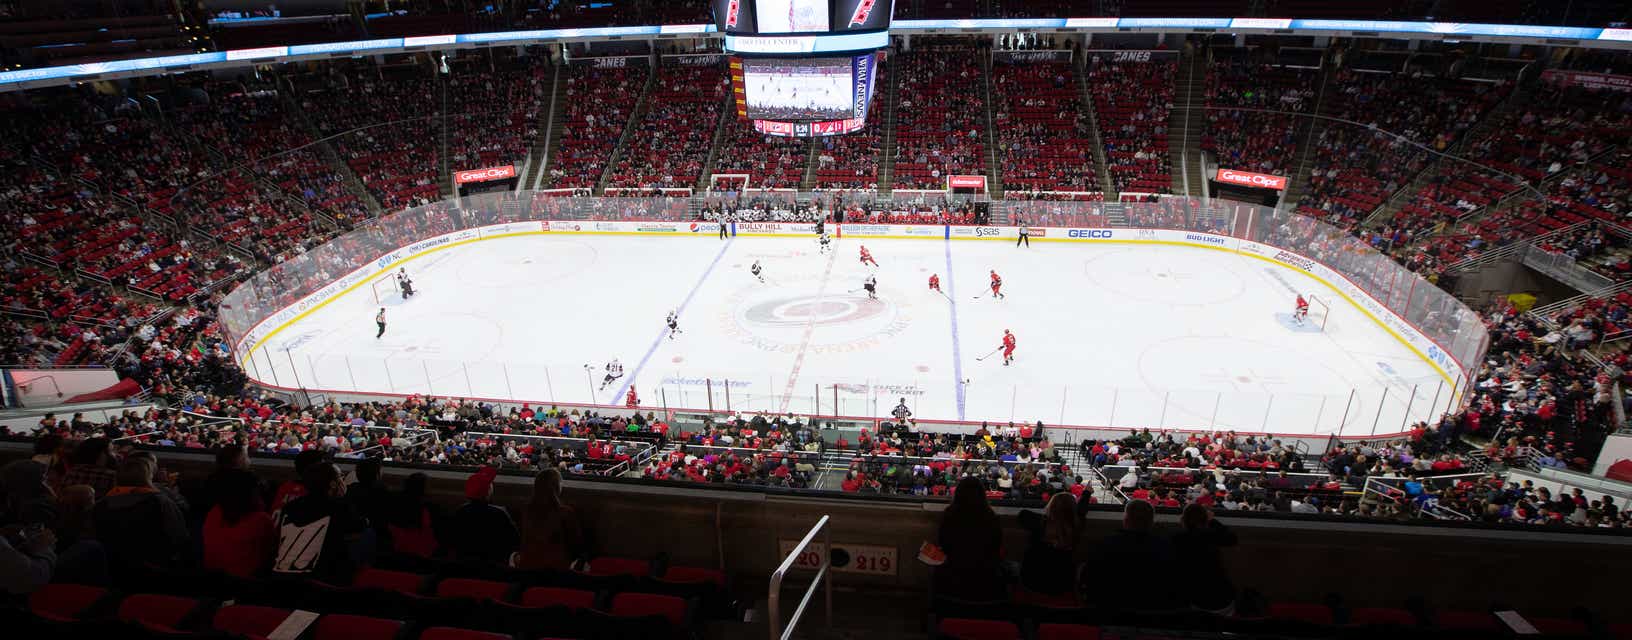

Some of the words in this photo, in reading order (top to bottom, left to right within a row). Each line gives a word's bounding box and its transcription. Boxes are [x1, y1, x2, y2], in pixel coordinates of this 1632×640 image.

[592, 57, 626, 69] CANES
[1113, 52, 1152, 62] CANES
[461, 172, 487, 180] Great
[487, 168, 509, 178] Clips
[1222, 171, 1252, 183] Great
[1252, 175, 1280, 187] Clips
[1068, 229, 1113, 239] GEICO
[1186, 233, 1202, 241] BUD
[1203, 236, 1225, 245] LIGHT
[856, 554, 891, 571] 219
